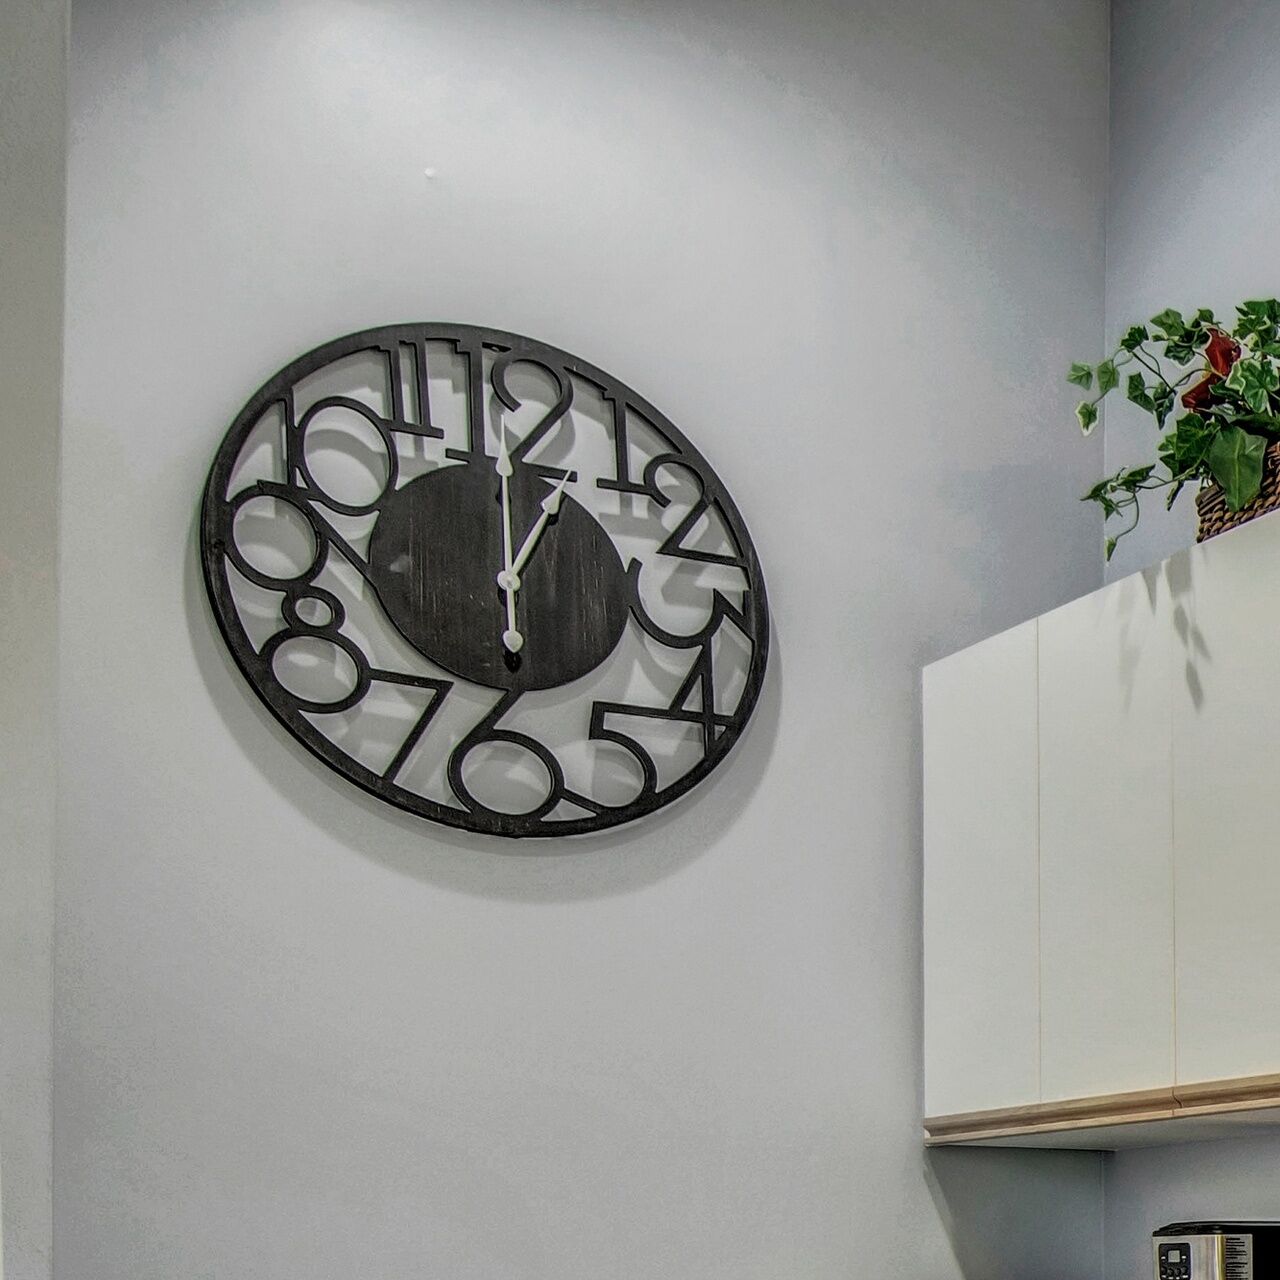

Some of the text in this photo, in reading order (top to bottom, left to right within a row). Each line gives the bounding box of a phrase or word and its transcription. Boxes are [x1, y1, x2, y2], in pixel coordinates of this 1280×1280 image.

[256, 392, 399, 517] 10
[445, 342, 578, 483] 12
[257, 581, 372, 714] 8
[368, 668, 455, 785] 7
[448, 687, 566, 822] 6
[560, 700, 658, 816] 5
